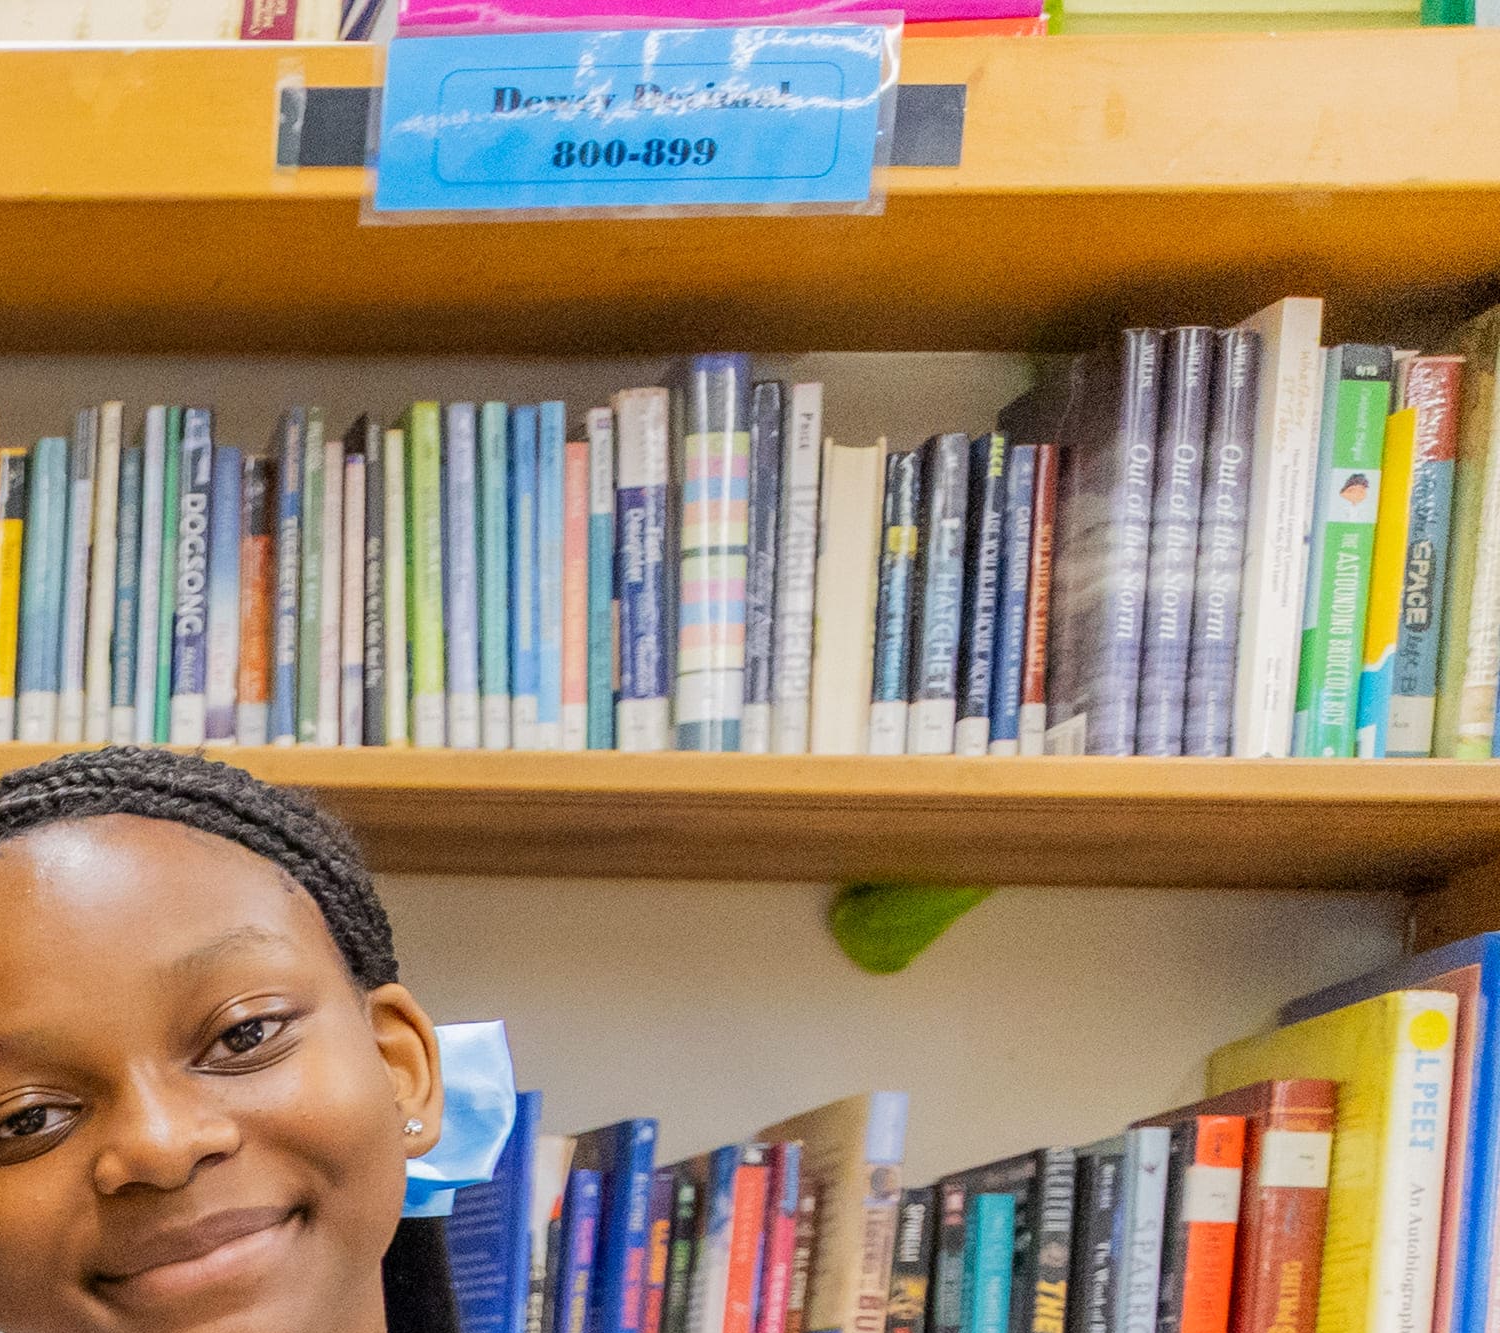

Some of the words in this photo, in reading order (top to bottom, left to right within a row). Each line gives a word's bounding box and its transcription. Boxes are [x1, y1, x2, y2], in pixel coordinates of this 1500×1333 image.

[492, 84, 615, 117] Dewey
[633, 80, 791, 113] Decimal
[552, 138, 717, 169] 800-899
[1119, 444, 1150, 486] Out
[1171, 444, 1197, 486] Out
[1217, 444, 1244, 486] Out
[1119, 494, 1149, 521] of
[1165, 494, 1195, 521] of
[1211, 494, 1242, 521] of
[175, 493, 206, 636] DOGSONG
[1119, 526, 1148, 563] the
[1165, 526, 1193, 563] the
[1211, 526, 1240, 563] the
[1328, 553, 1362, 635] ASTOUNDING
[1404, 541, 1431, 626] SPACE
[1116, 568, 1145, 642] Storm
[1158, 568, 1189, 642] Storm
[1205, 568, 1235, 642] Storm
[928, 572, 956, 695] HATCHET
[1324, 639, 1354, 697] BROCCOLI
[1320, 701, 1346, 726] BOY
[1407, 1184, 1427, 1208] An
